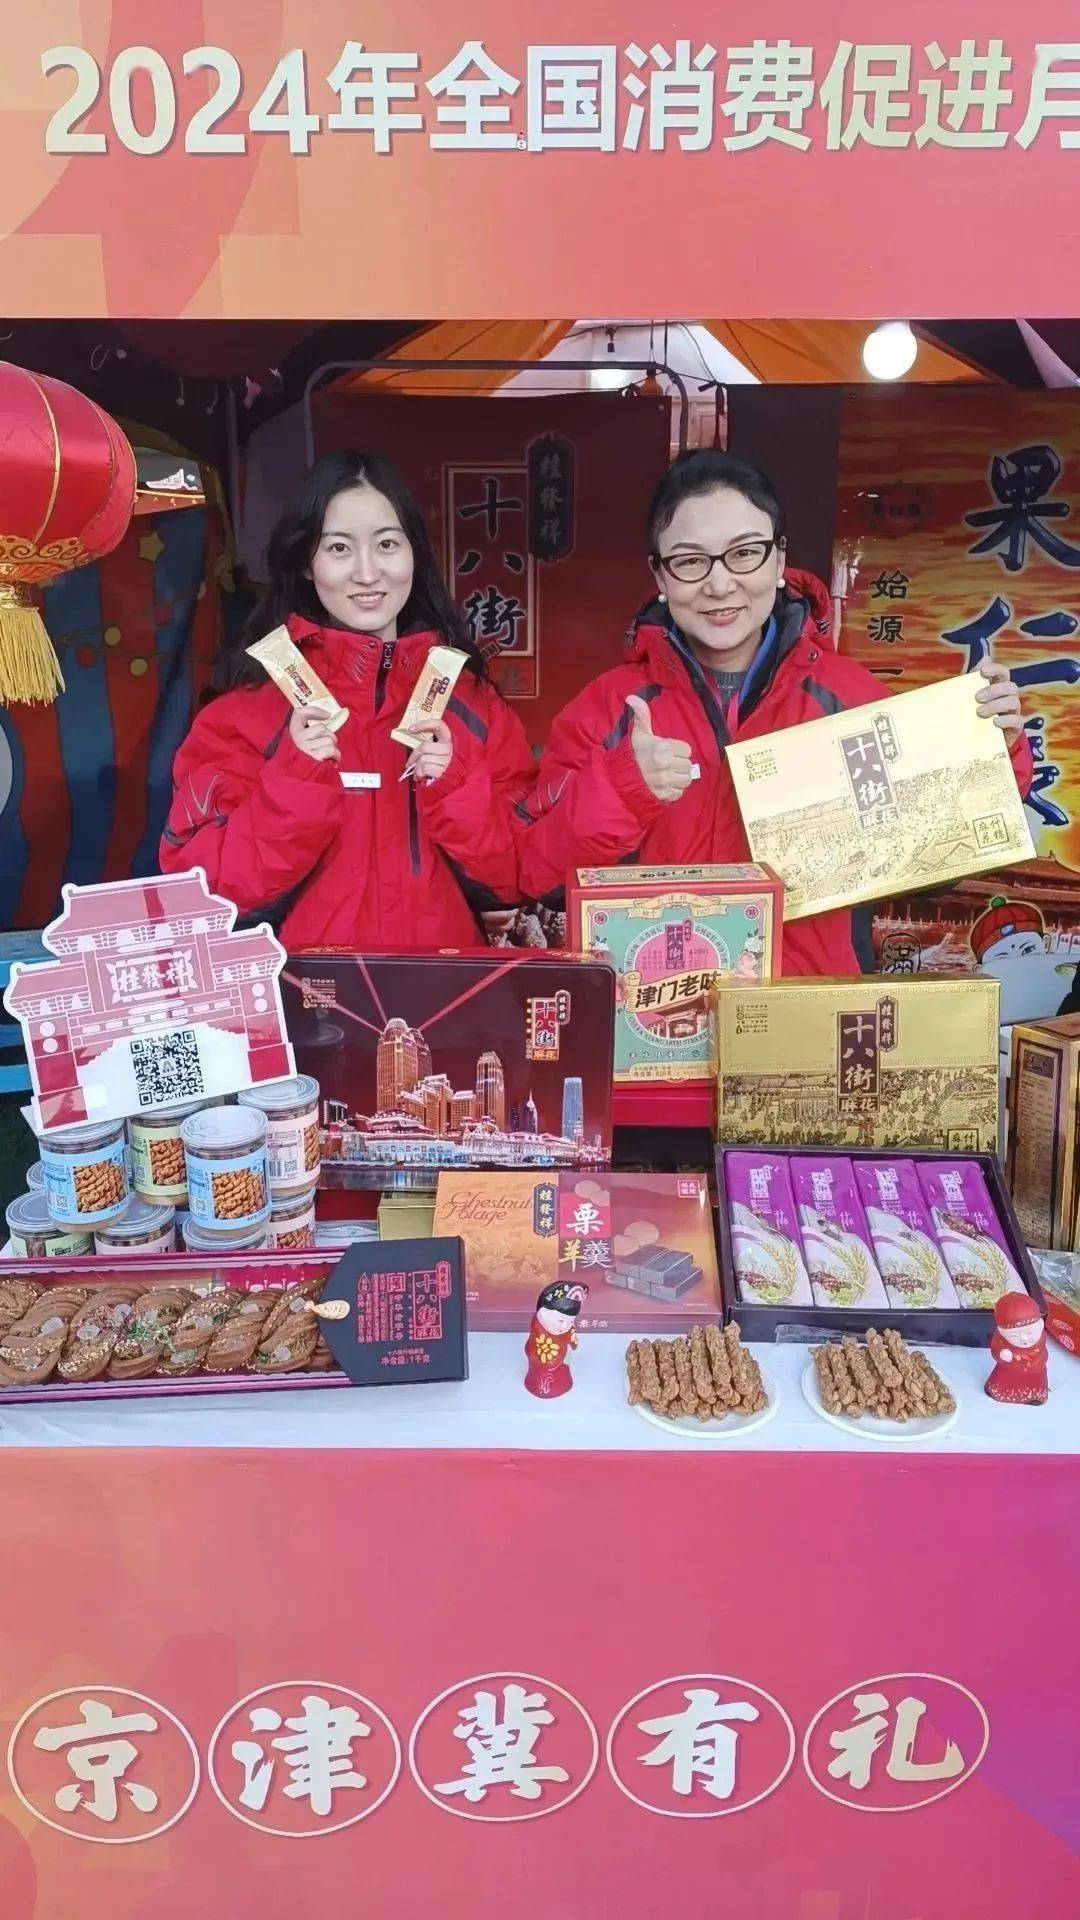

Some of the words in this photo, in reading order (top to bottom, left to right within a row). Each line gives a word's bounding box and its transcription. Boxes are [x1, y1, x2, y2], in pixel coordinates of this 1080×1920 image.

[39, 40, 1080, 156] 2024年全国消费促进月
[457, 477, 525, 648] 十八街
[846, 736, 888, 807] 十八街
[843, 1015, 875, 1092] 十八街
[416, 1273, 439, 1326] 十八街
[32, 1684, 965, 1822] 京津冀有礼
